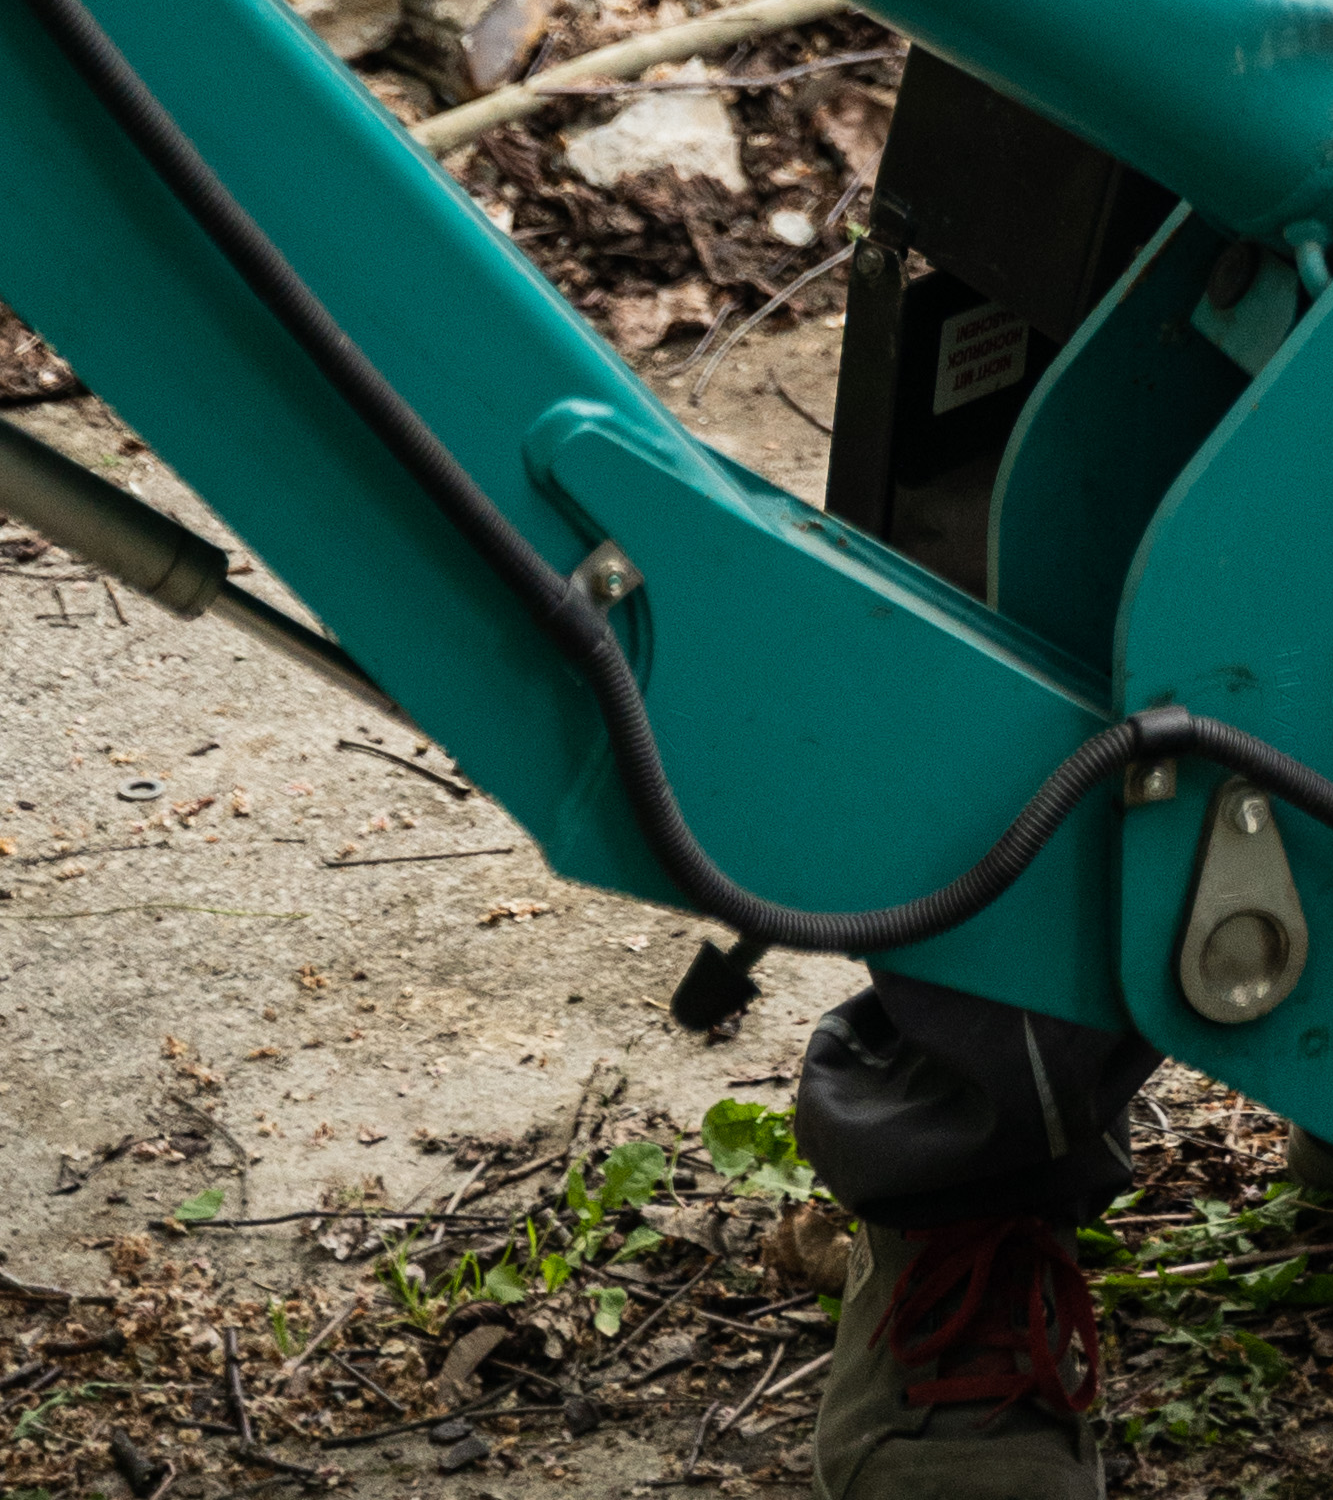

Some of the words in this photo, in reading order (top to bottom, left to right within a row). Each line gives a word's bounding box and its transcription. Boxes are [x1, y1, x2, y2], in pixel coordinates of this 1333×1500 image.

[947, 327, 1022, 369] HOCHDRUCK
[954, 368, 973, 391] MIT
[977, 353, 1012, 381] NICHT
